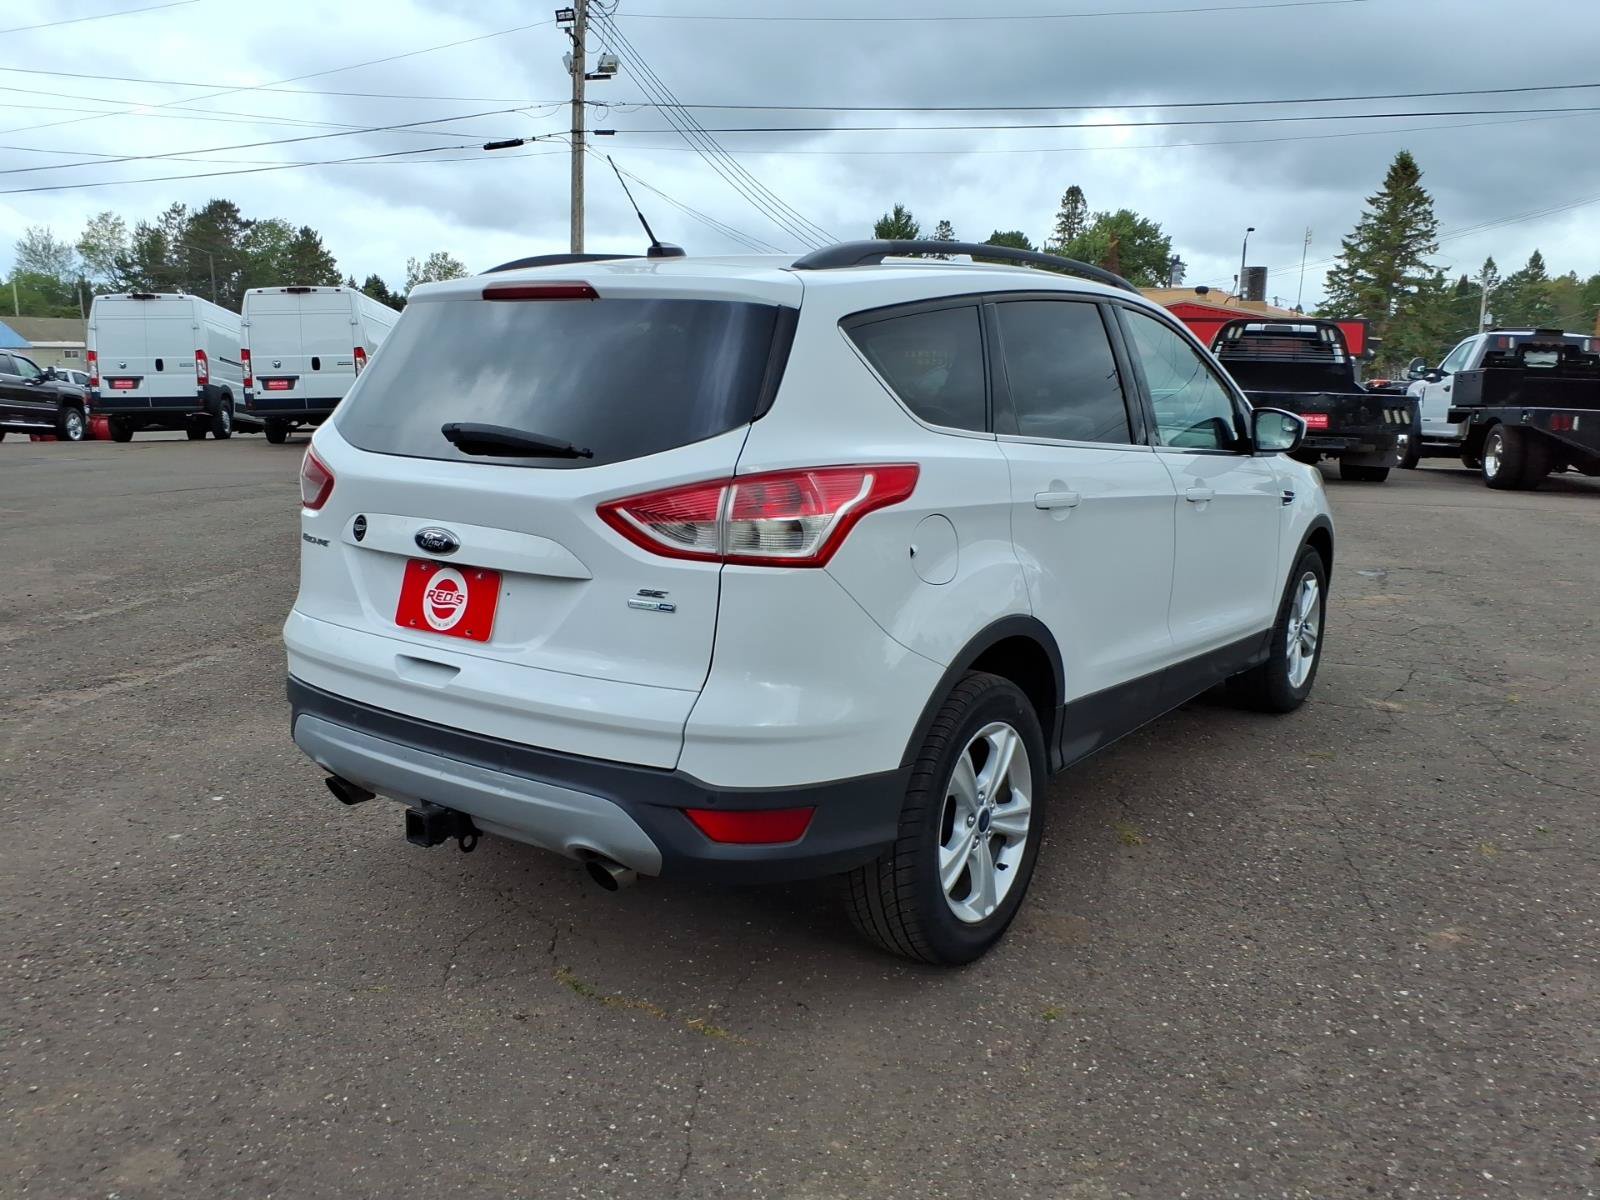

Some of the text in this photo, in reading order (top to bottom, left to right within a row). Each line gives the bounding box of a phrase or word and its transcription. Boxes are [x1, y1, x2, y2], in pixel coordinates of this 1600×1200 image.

[421, 531, 447, 549] Ford
[426, 589, 465, 605] RED'S
[636, 589, 669, 599] SE
